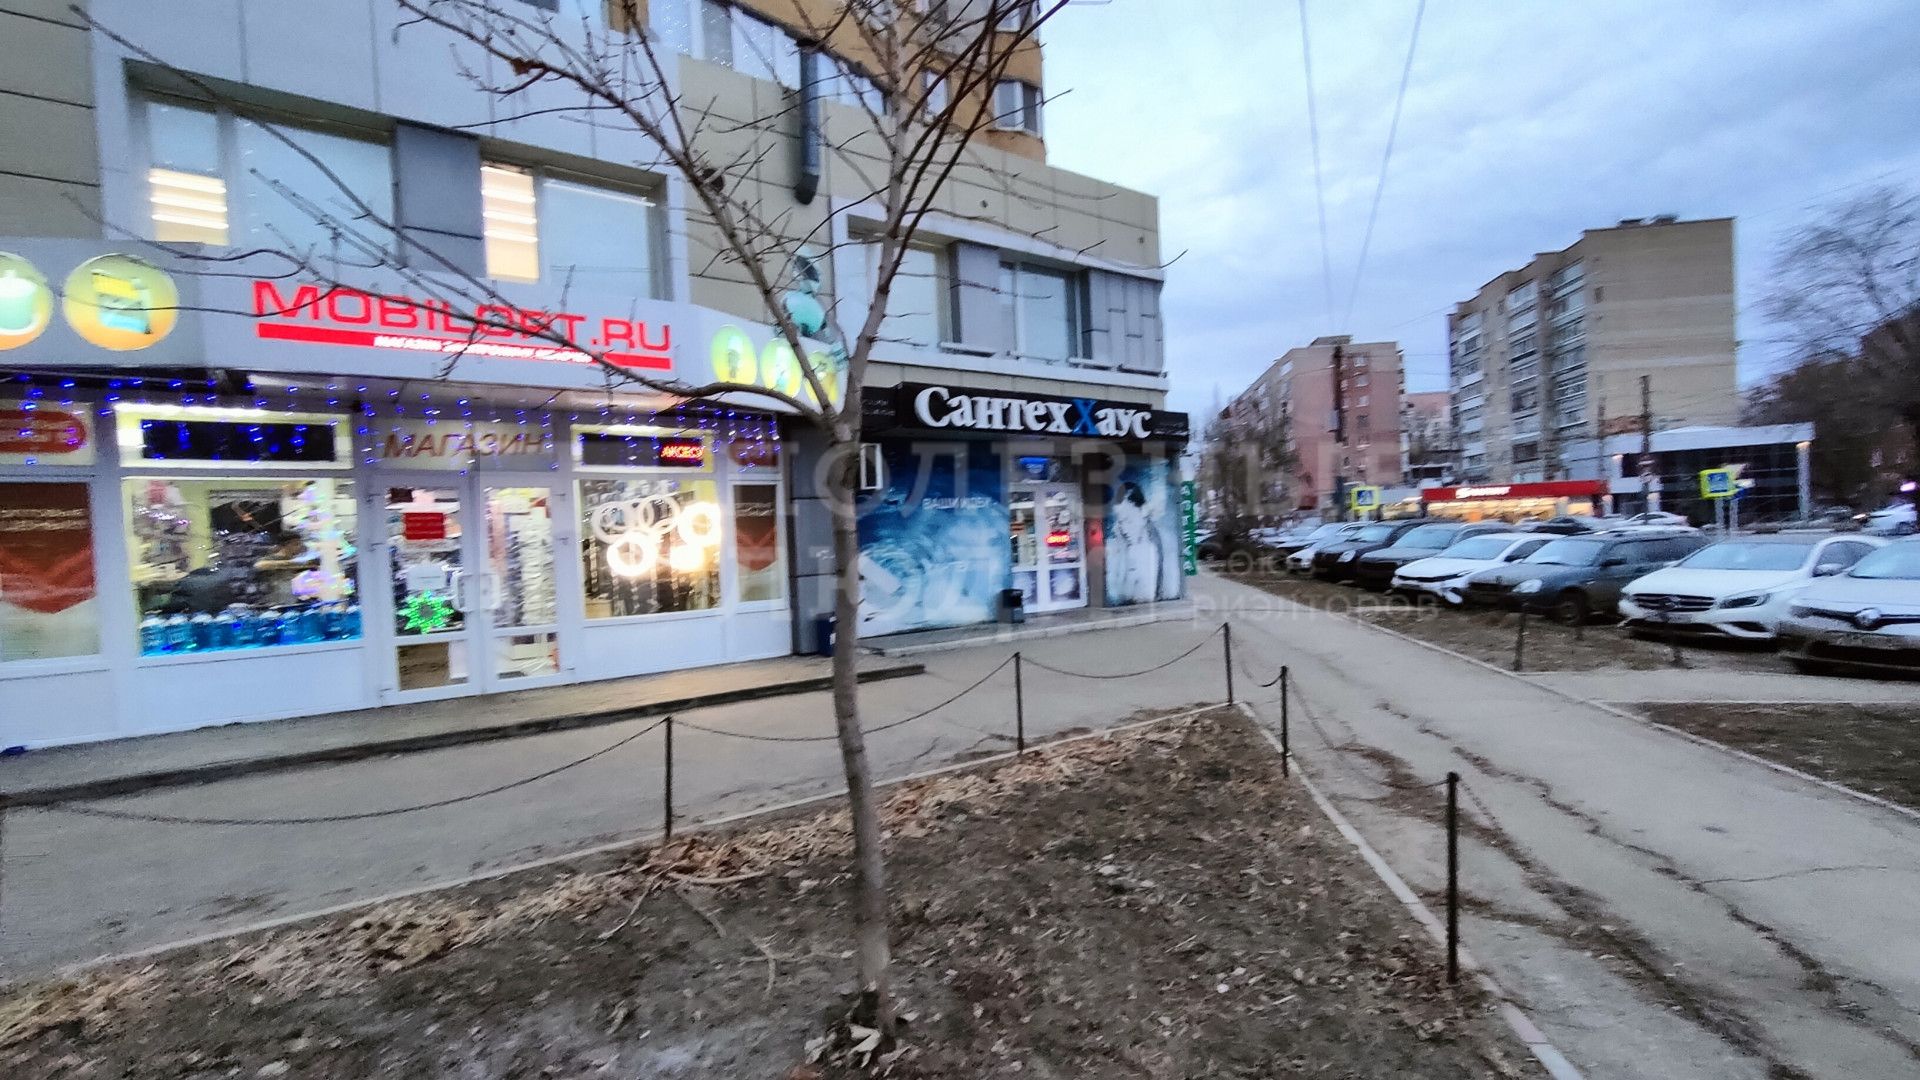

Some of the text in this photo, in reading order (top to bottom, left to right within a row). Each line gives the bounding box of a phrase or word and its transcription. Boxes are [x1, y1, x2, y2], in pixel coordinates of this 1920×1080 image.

[252, 280, 671, 351] MOBILOPT.RU
[914, 386, 1152, 439] СантехХаус
[383, 433, 544, 458] МАГАЗИН
